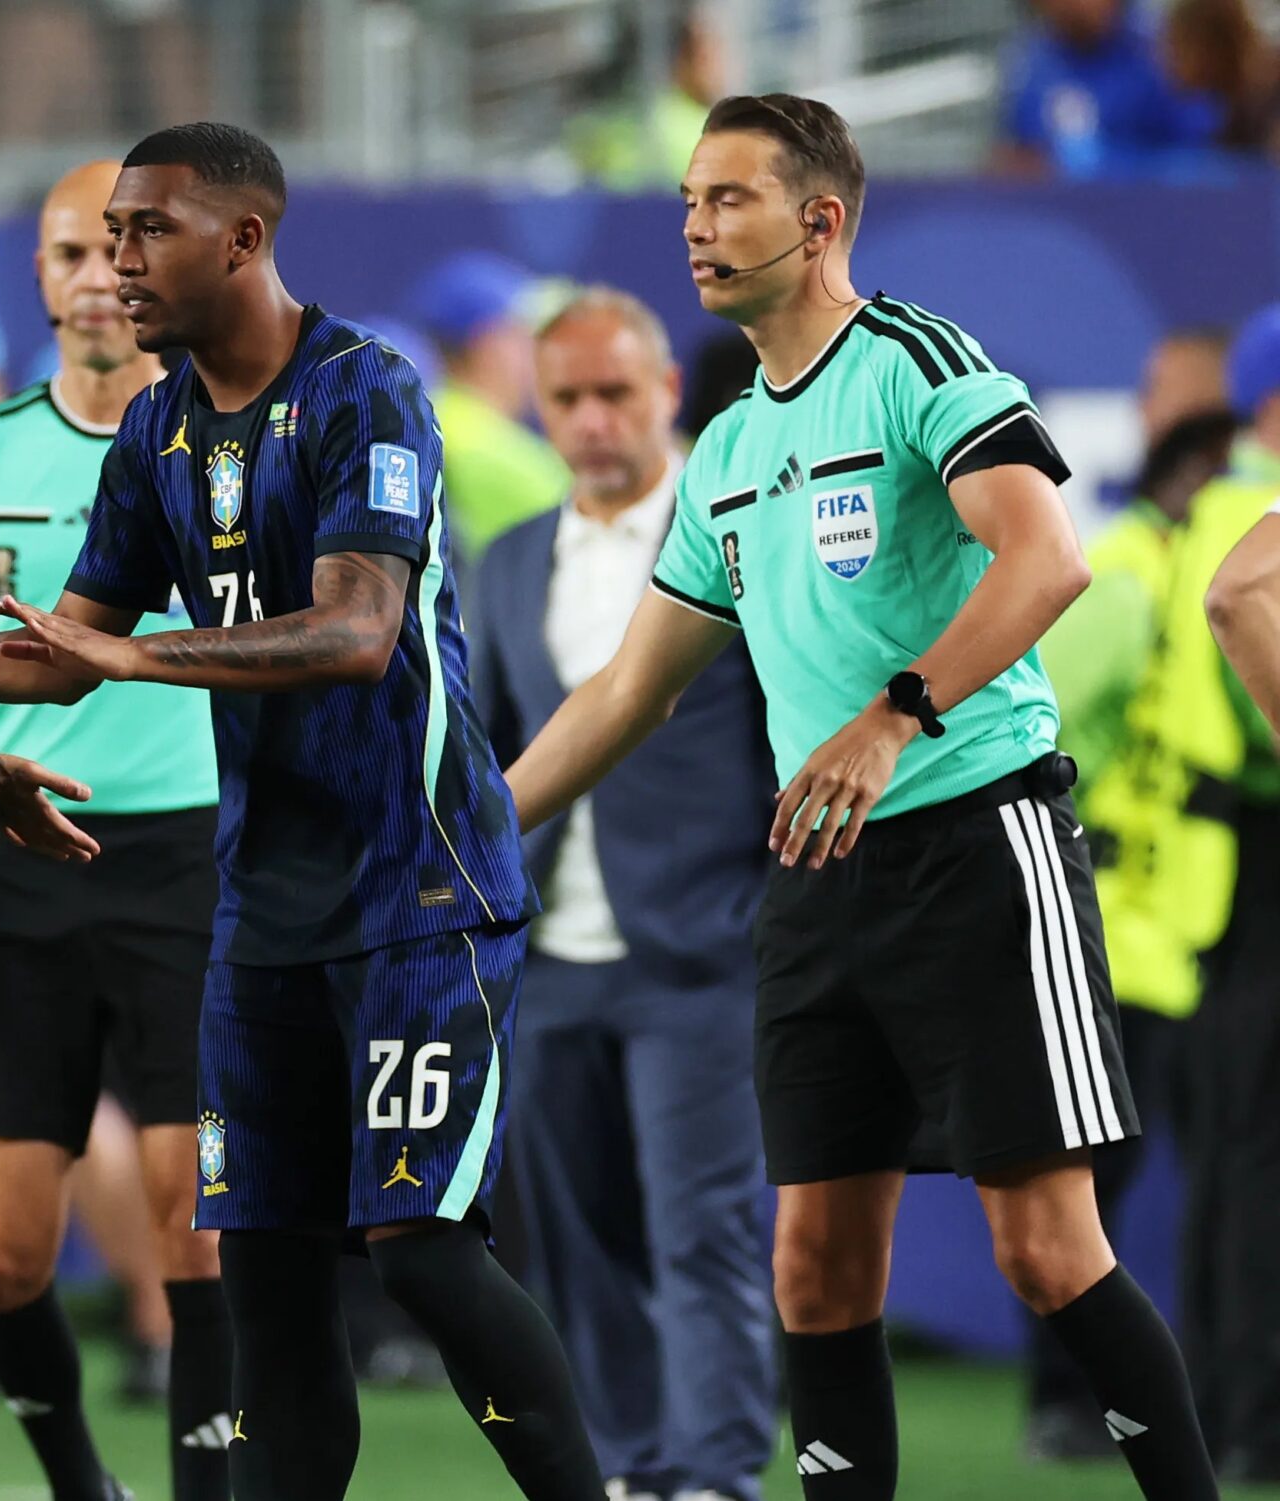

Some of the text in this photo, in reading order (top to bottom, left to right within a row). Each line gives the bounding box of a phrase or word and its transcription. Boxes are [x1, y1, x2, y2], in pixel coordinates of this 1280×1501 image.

[817, 493, 868, 520] FIFA
[819, 528, 872, 546] REFEREE
[836, 560, 861, 574] 2026
[366, 1040, 452, 1129] 26
[203, 1181, 230, 1197] BRASIL
